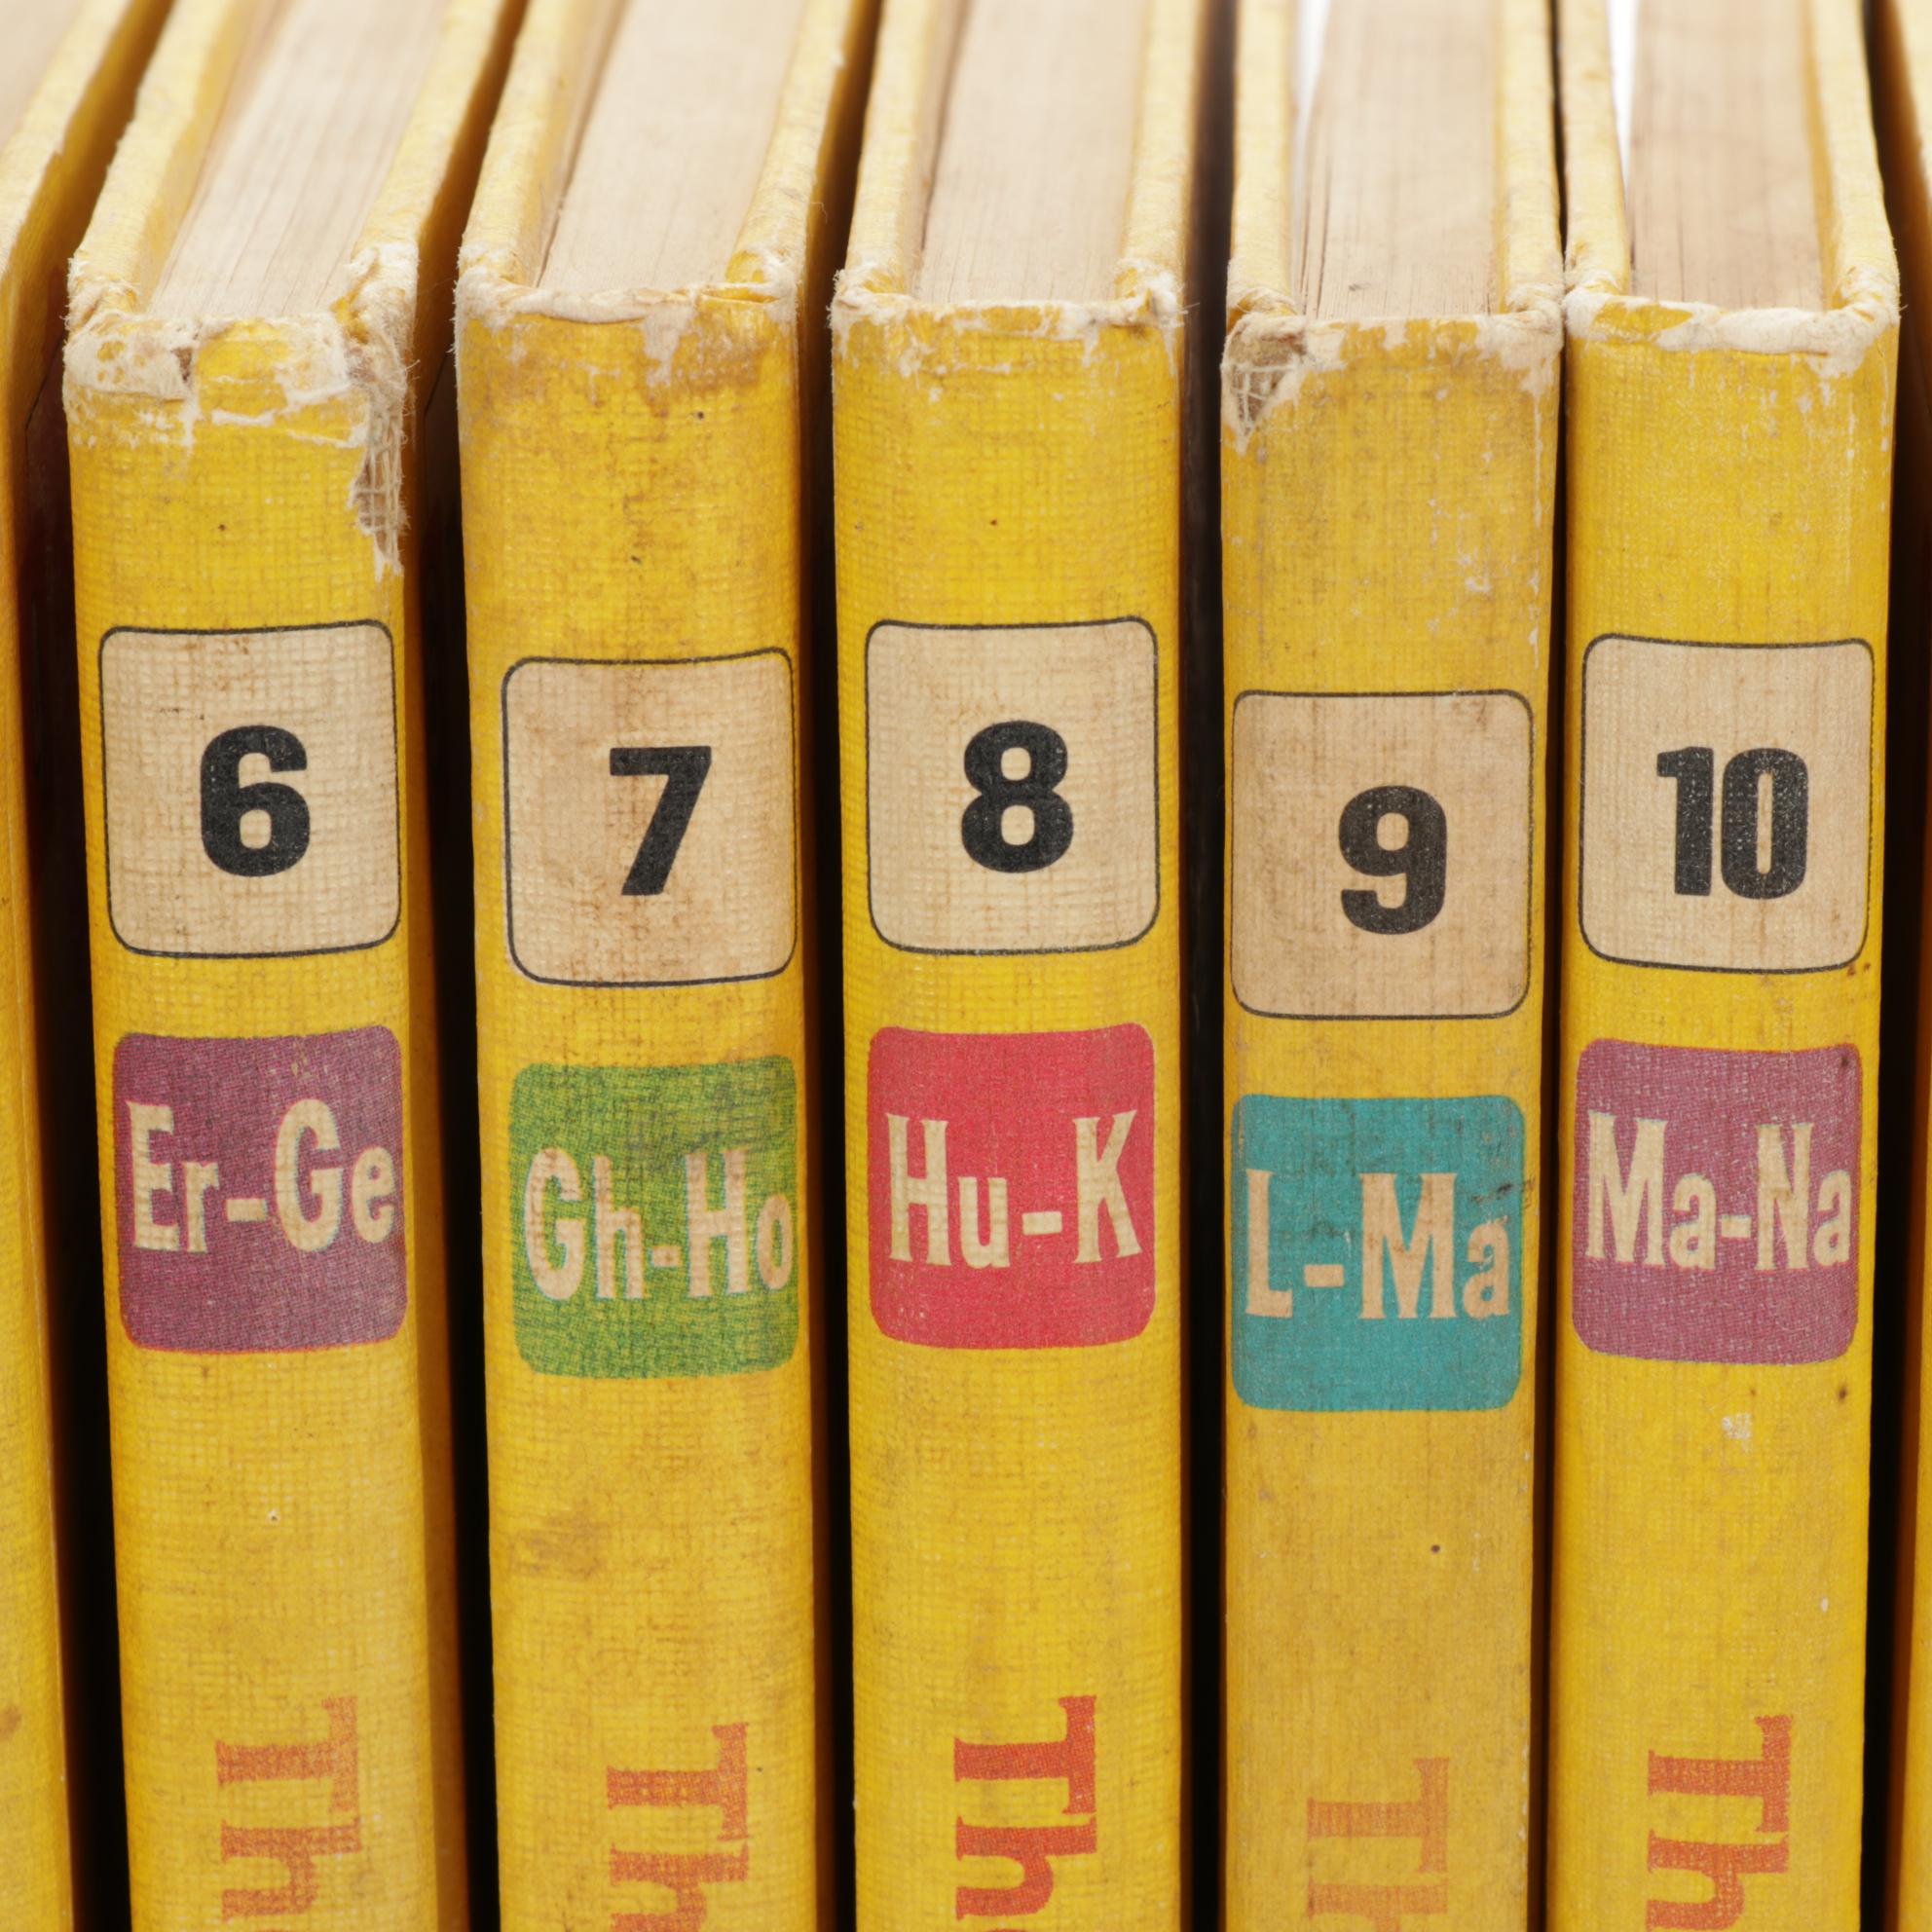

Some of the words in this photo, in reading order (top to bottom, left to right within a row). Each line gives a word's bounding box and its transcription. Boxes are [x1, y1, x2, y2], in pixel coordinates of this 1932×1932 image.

[200, 724, 310, 876] 6
[610, 745, 712, 896] 7
[961, 720, 1074, 874] 8
[1339, 785, 1447, 935] 9
[1656, 746, 1809, 900] 10
[128, 1098, 395, 1253] Er-Ge
[524, 1147, 794, 1301] Gh-Ho
[885, 1109, 1142, 1268] Hu-K
[1245, 1170, 1510, 1320] L-Ma
[1585, 1110, 1852, 1272] Ma-Na
[215, 1695, 361, 1932] Th
[953, 1695, 1096, 1932] Th
